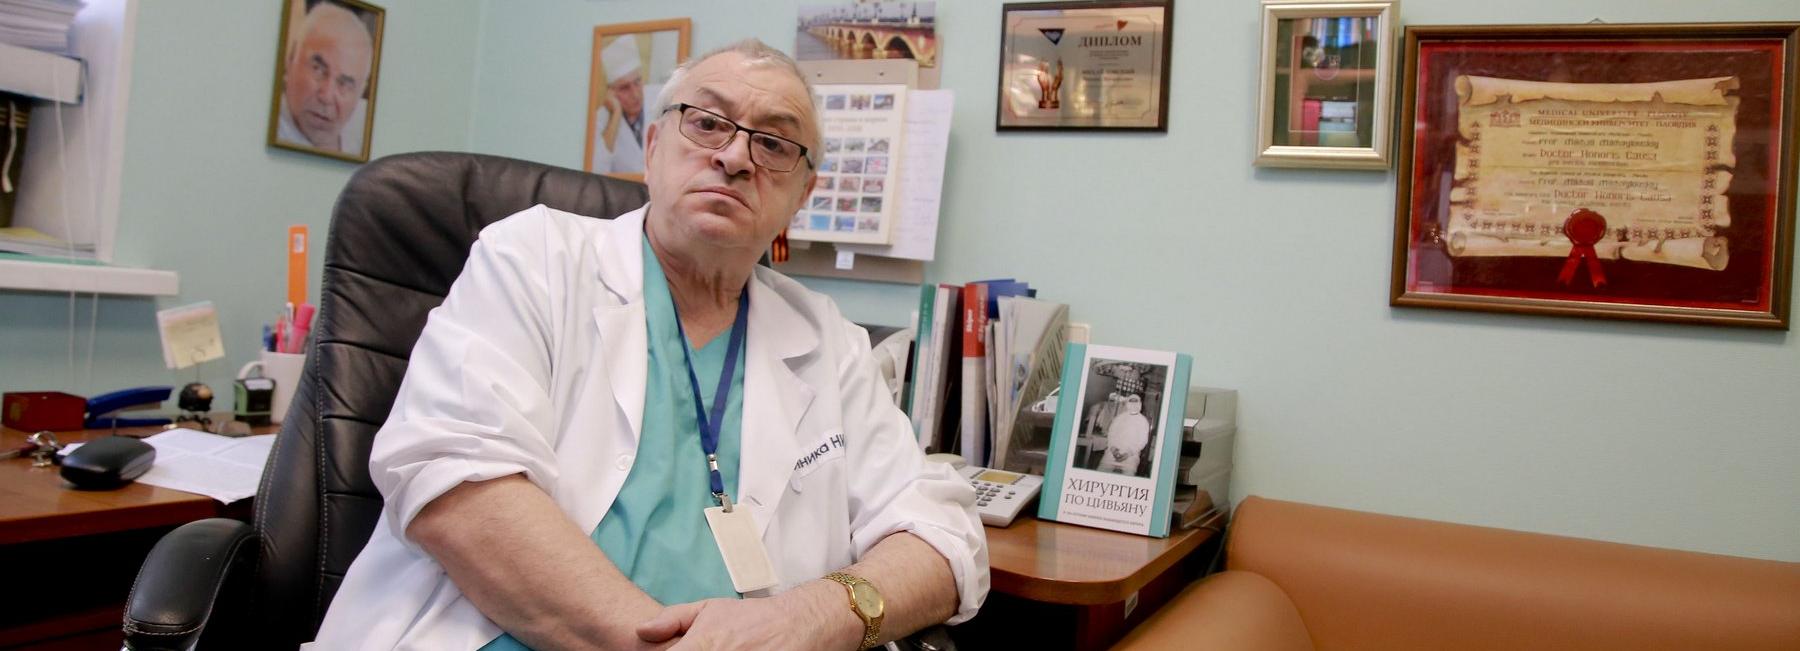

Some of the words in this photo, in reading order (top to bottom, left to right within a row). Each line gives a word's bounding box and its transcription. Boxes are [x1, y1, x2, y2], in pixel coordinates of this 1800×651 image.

[1078, 34, 1143, 48] ДИПЛОМ
[1067, 478, 1150, 501] ХИРУРГИЯ
[1064, 493, 1085, 506] ПО
[1086, 497, 1148, 517] ЦИВЬЯНУ
